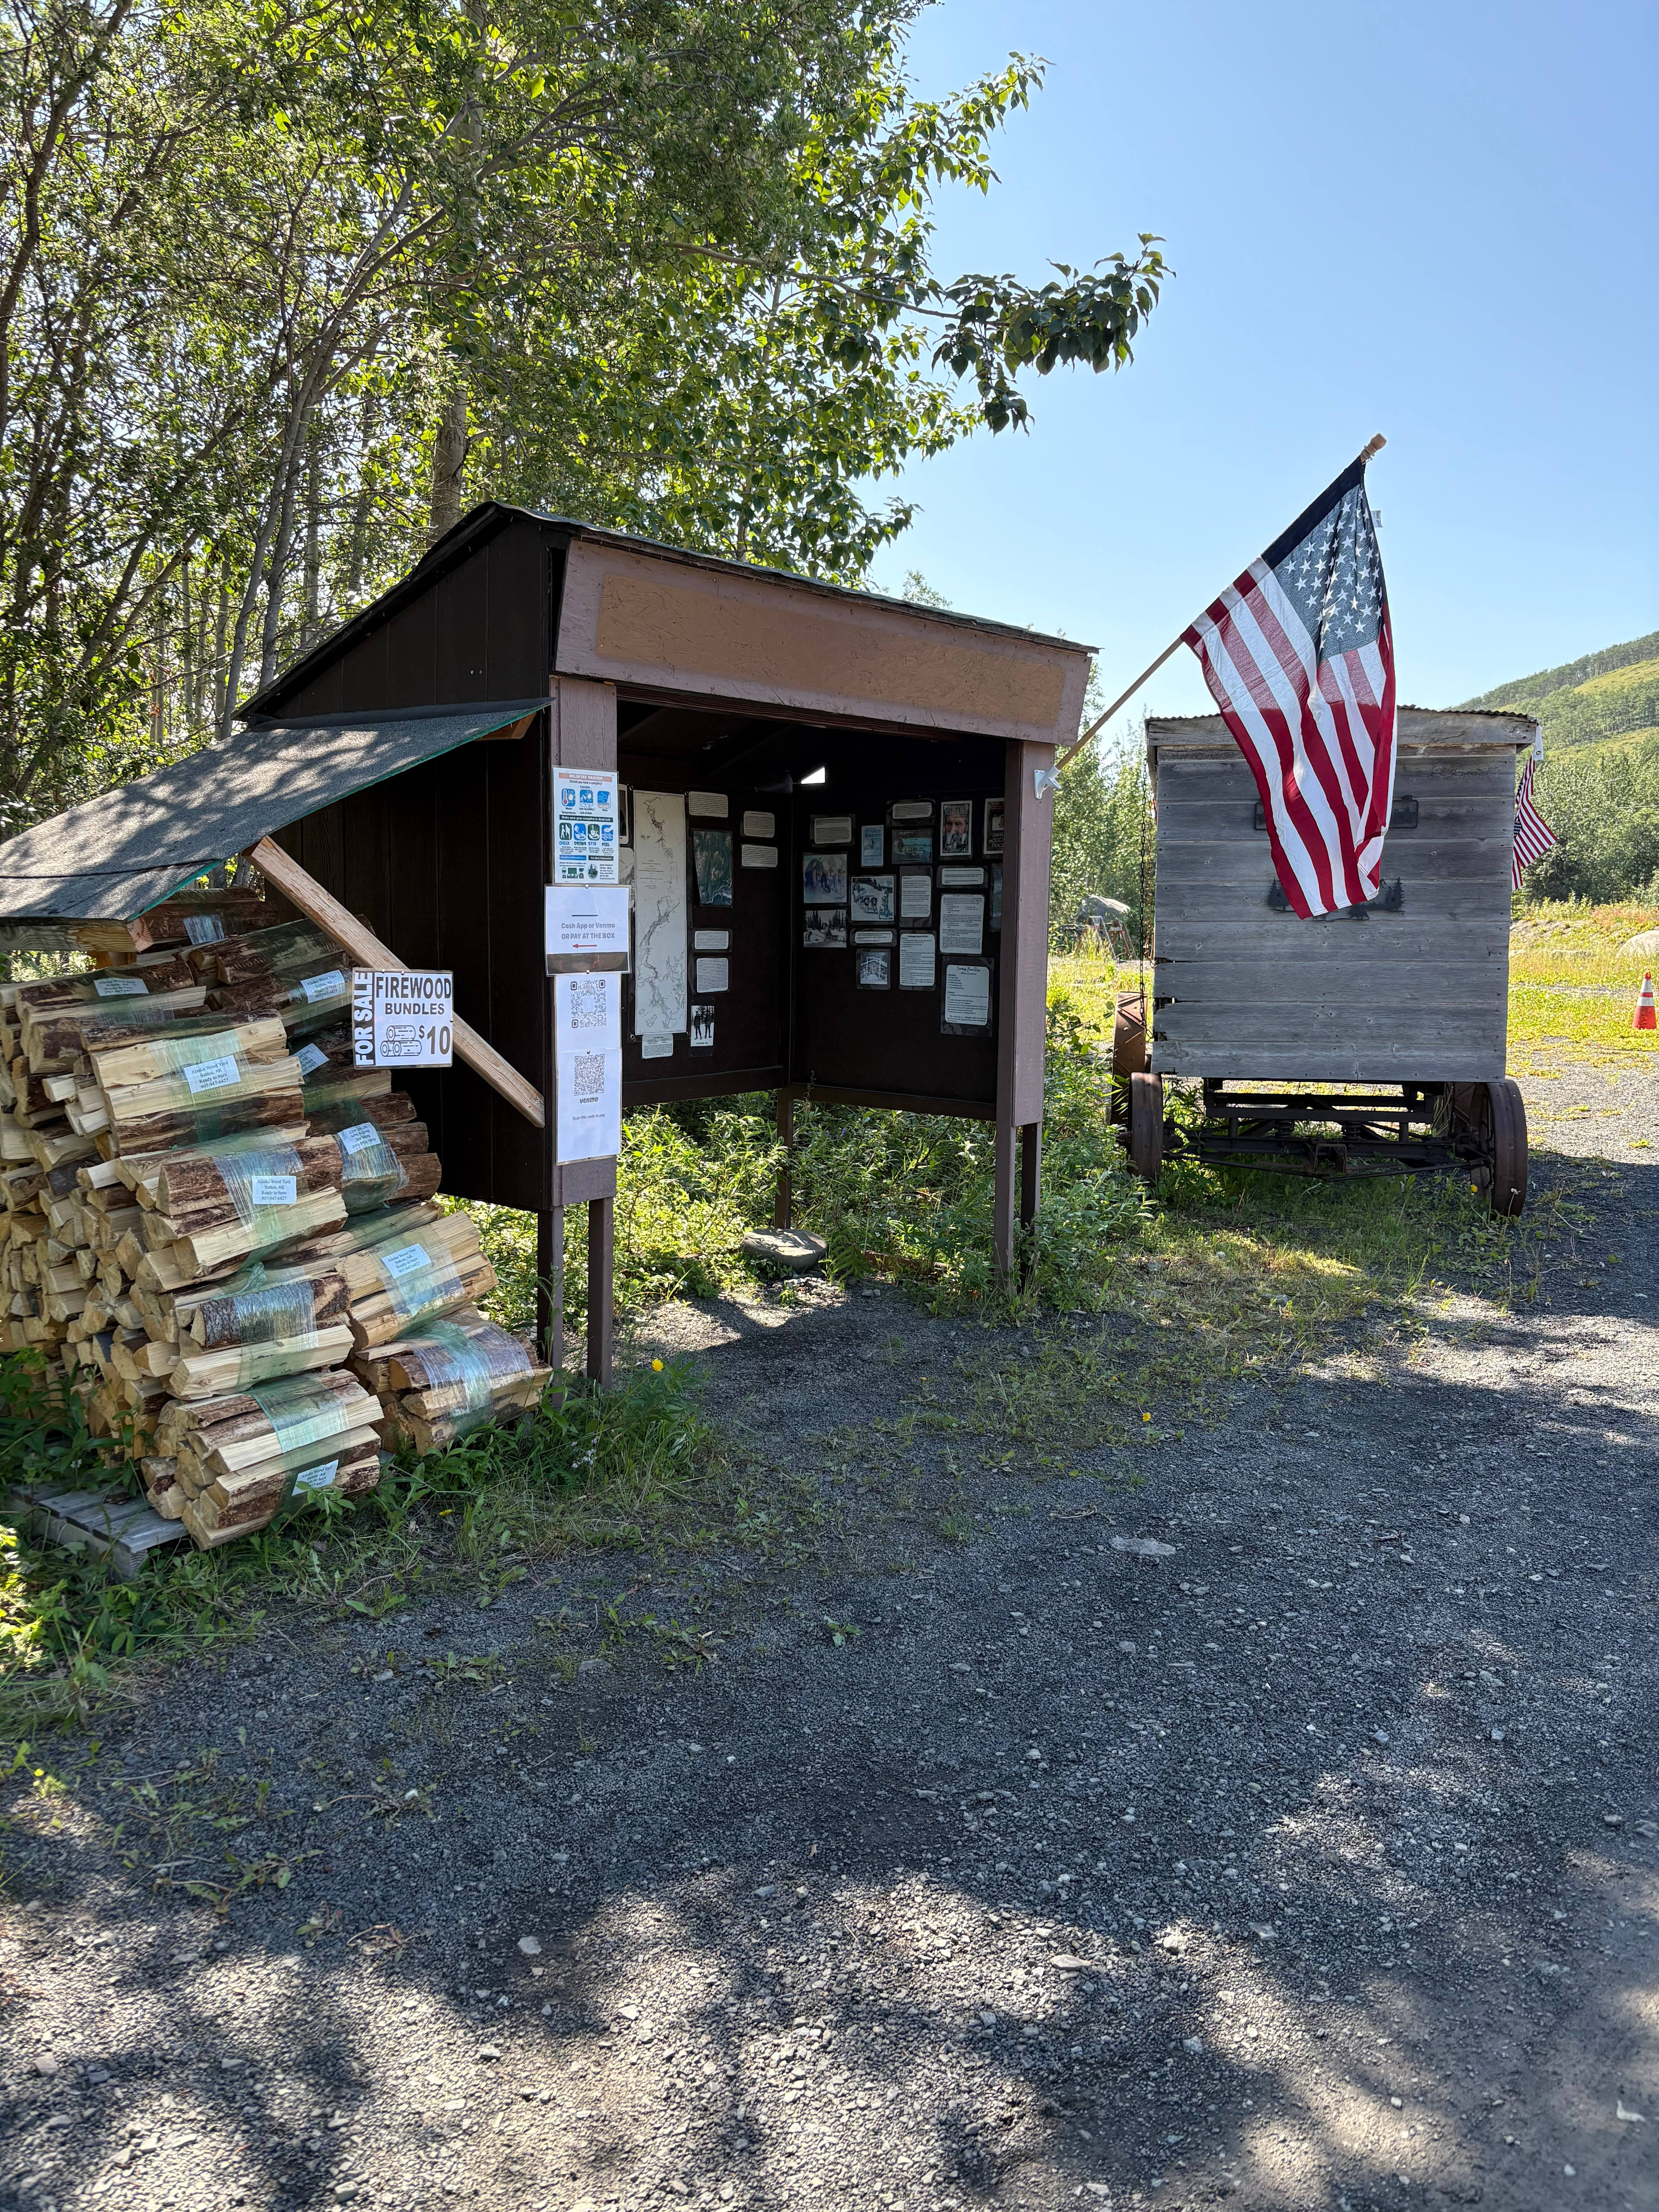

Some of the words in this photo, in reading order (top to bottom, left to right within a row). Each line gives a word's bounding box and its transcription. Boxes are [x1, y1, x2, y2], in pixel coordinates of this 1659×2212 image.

[354, 973, 373, 1021] SALE
[376, 977, 451, 999] FIREWOOD
[385, 1003, 445, 1014] BUNDLES
[355, 1027, 374, 1065] FOR
[419, 1025, 450, 1055] $10
[200, 1078, 228, 1089] 907-947-6427
